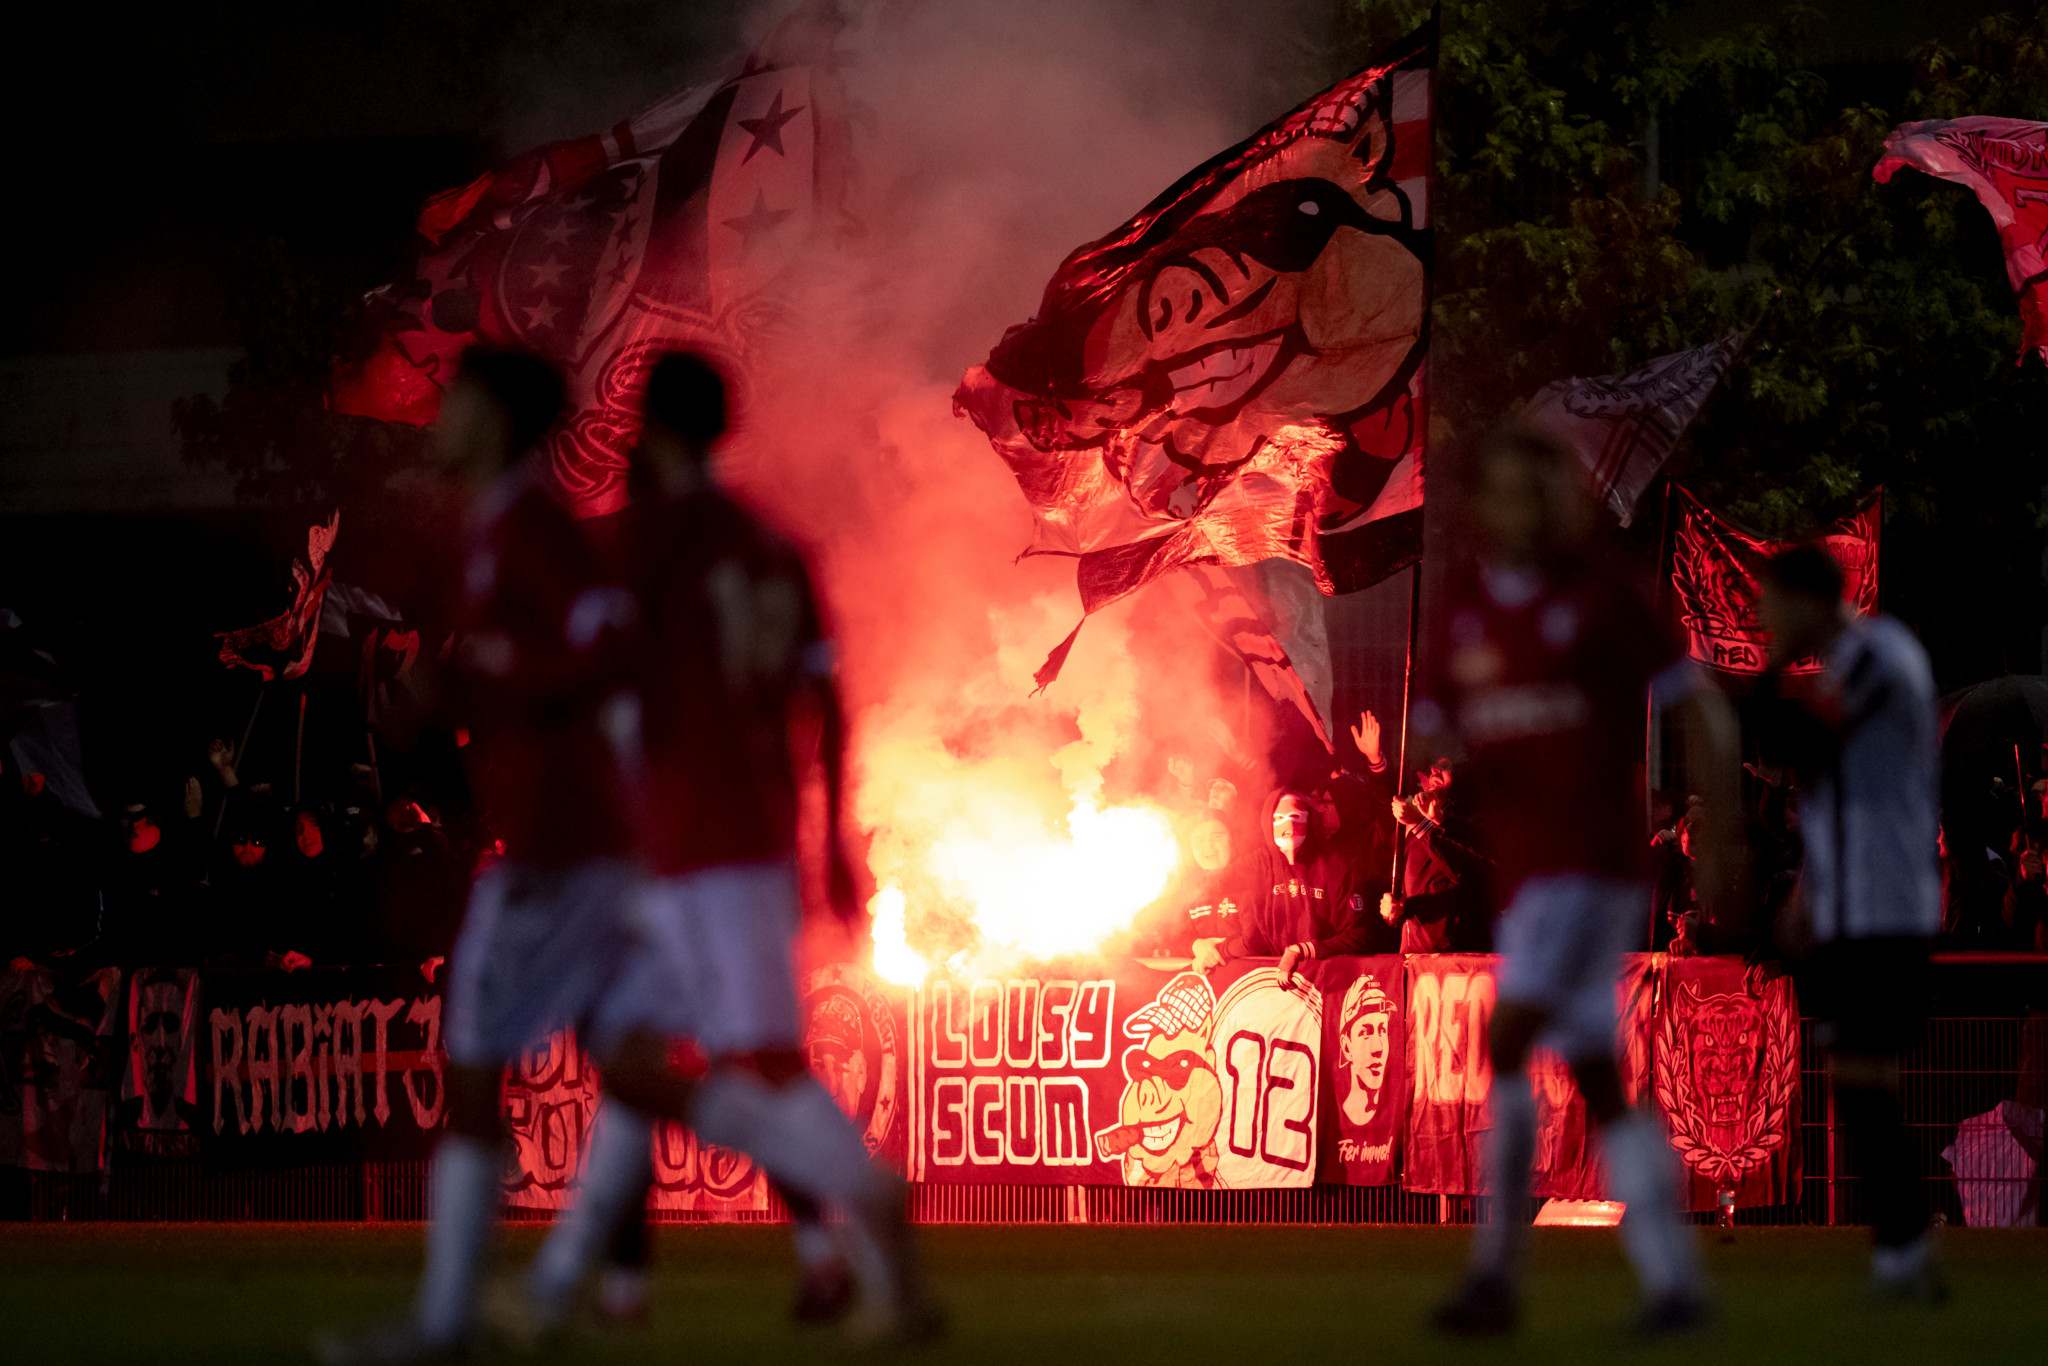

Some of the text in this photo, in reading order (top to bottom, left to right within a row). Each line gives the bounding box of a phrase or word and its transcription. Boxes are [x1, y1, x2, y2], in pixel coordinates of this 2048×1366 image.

[1713, 643, 1759, 666] RED
[931, 979, 1116, 1069] LOUSY
[931, 1075, 1093, 1166] SCUM
[1225, 1029, 1318, 1172] 12
